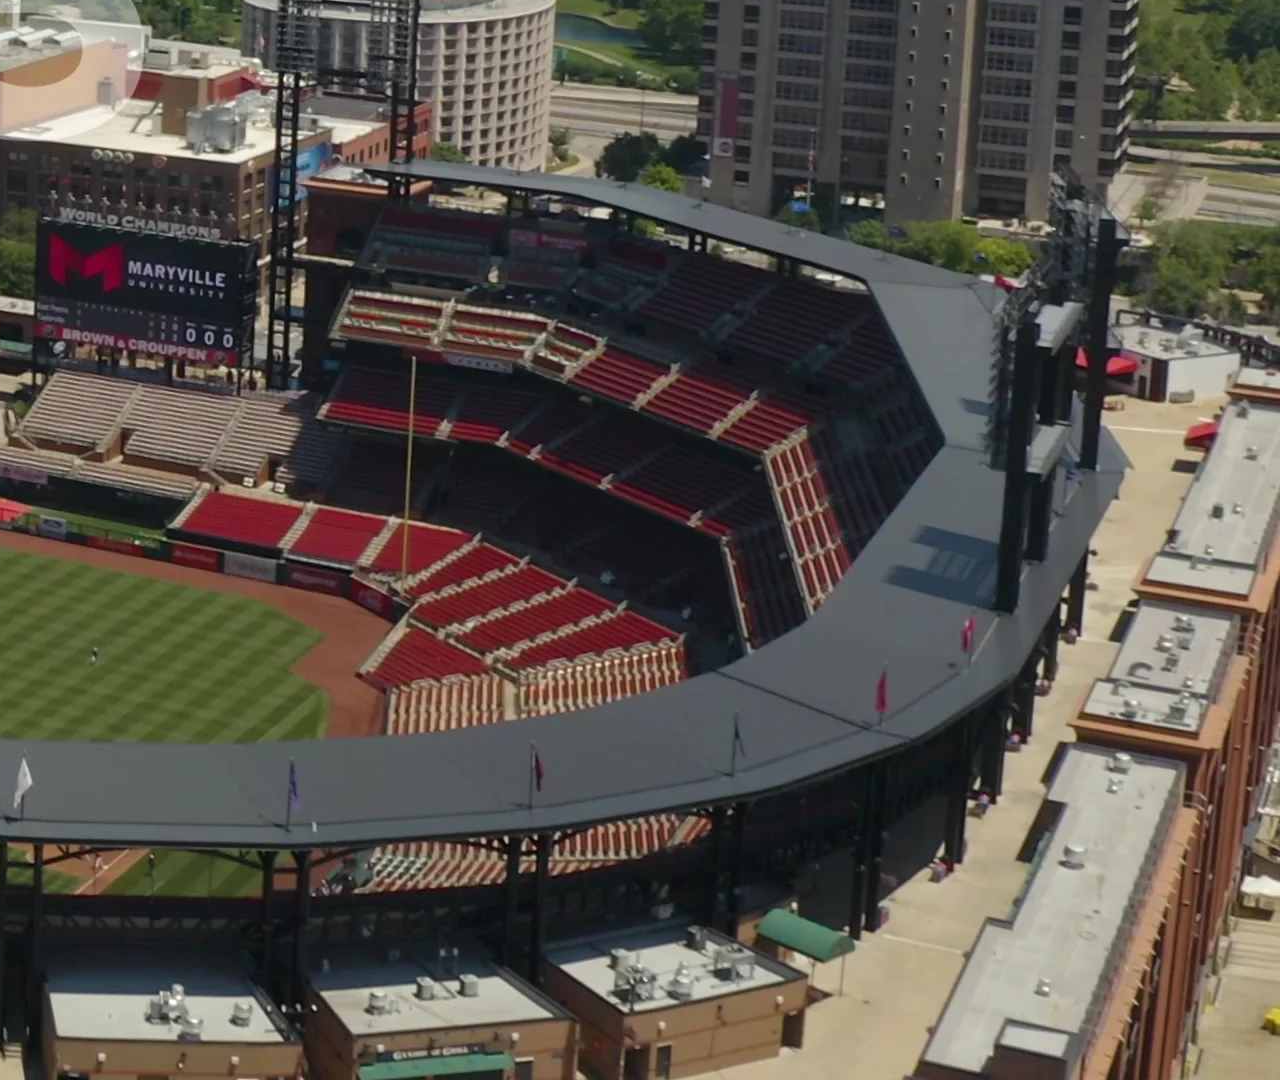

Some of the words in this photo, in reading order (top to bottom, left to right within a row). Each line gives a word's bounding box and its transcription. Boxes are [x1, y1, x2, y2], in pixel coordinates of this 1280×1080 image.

[59, 207, 118, 226] WORLD
[122, 216, 221, 239] CHAMPIONS
[128, 260, 226, 288] MARYVILLE
[128, 278, 224, 300] UNIVERSITY
[62, 328, 114, 347] BROWN
[128, 338, 207, 361] CROUPPEN
[186, 328, 196, 342] 0
[204, 331, 214, 345] 0
[223, 334, 233, 348] 0
